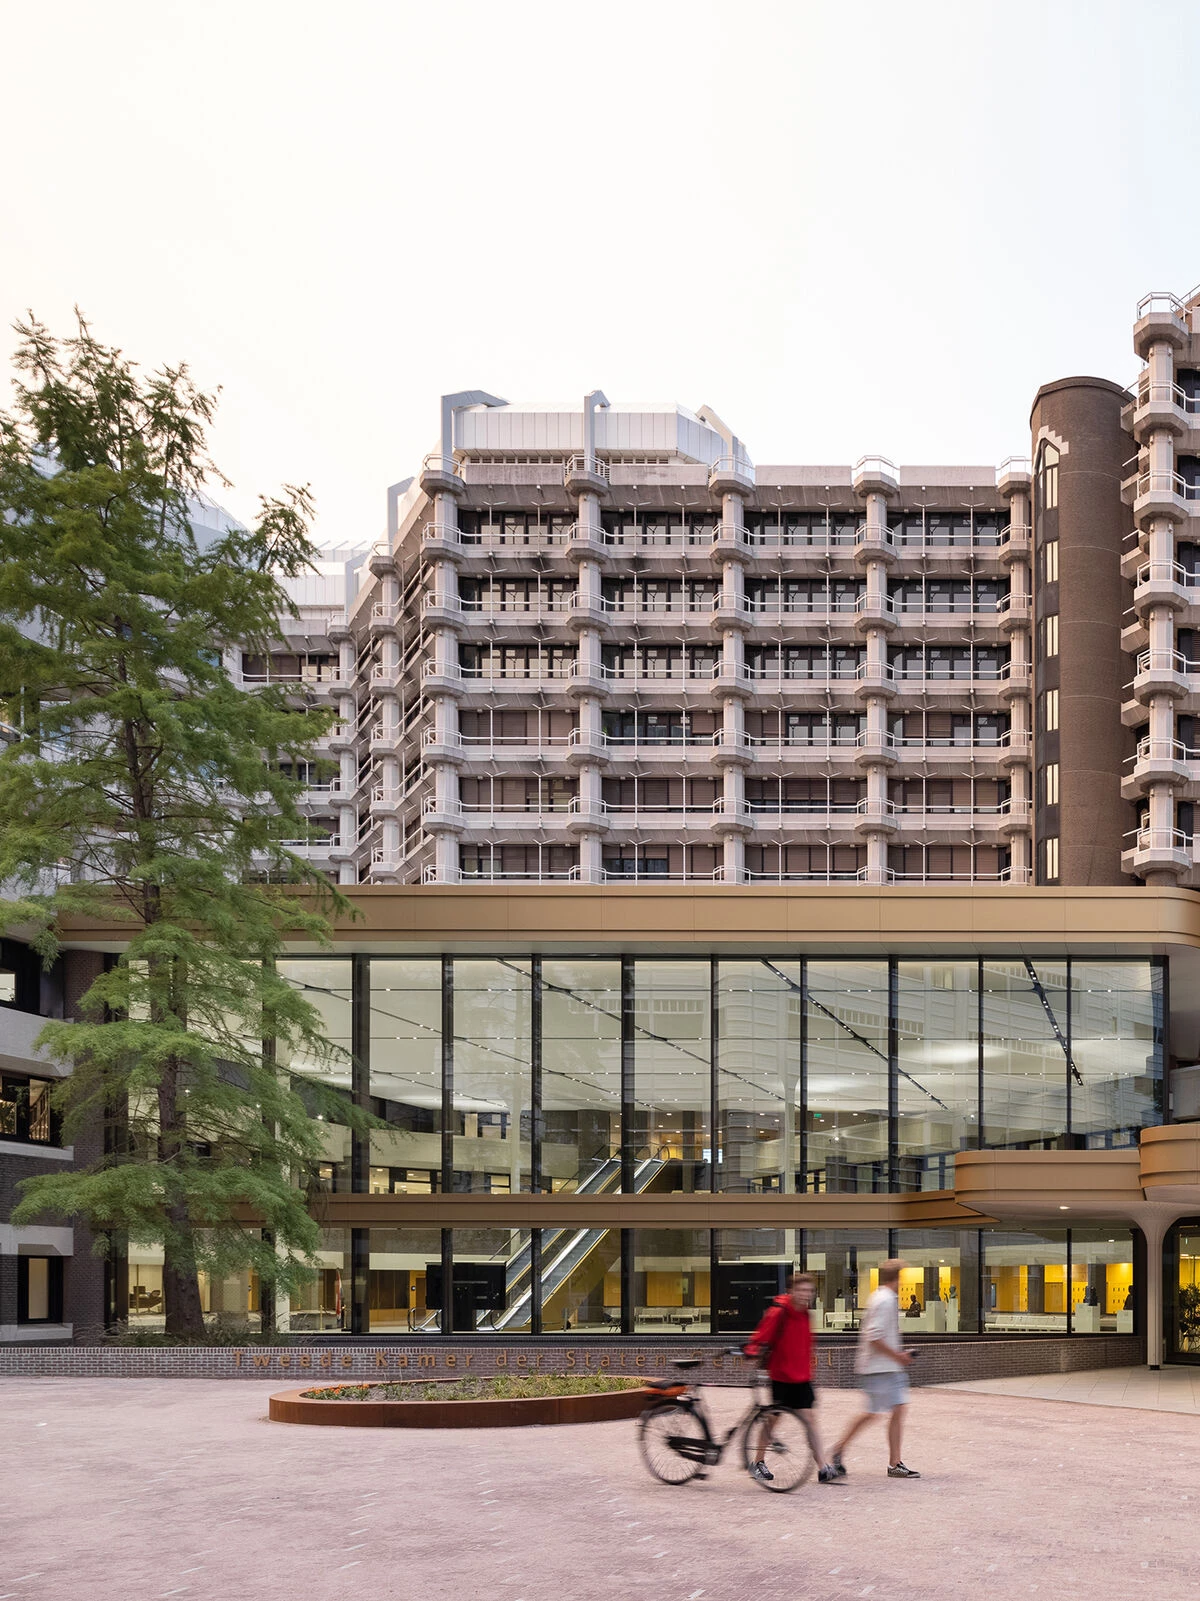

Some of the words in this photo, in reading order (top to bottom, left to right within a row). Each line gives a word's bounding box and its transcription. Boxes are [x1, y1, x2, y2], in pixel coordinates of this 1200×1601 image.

[233, 1351, 352, 1367] Tweede
[375, 1351, 474, 1367] Kamer
[496, 1350, 543, 1367] der
[566, 1350, 667, 1367] Staten
